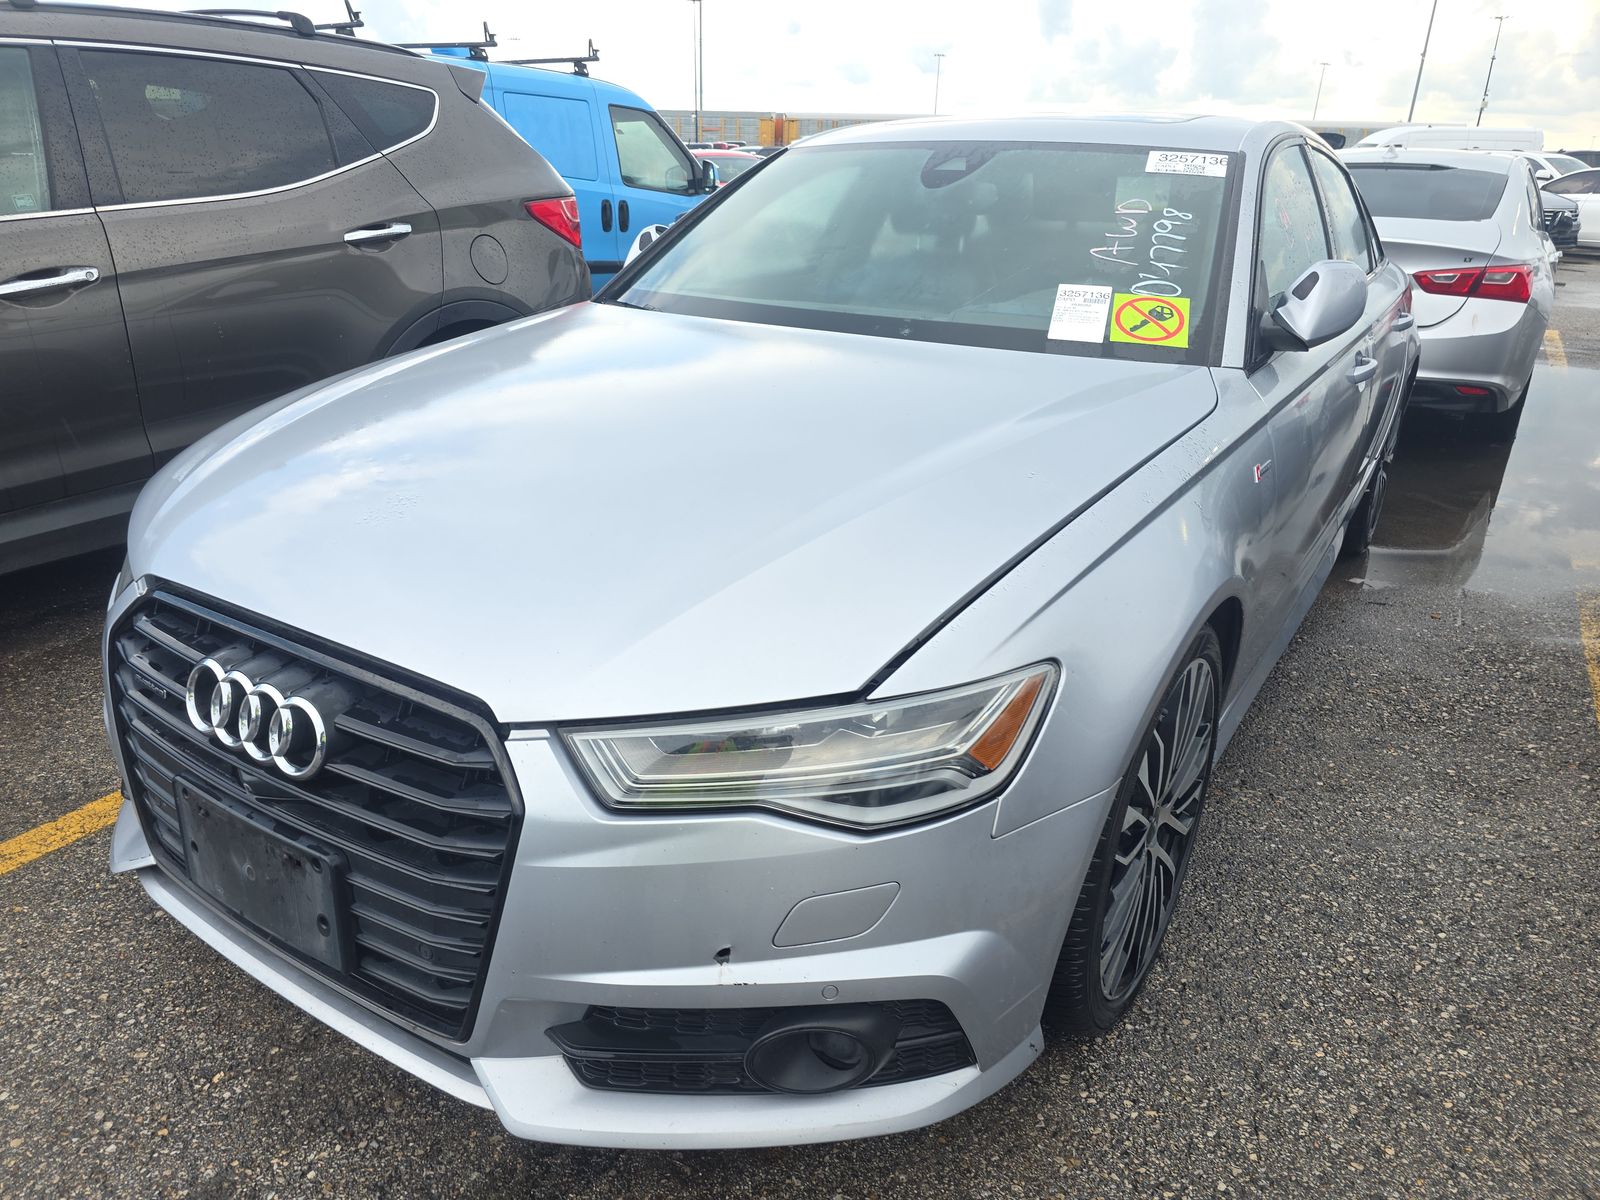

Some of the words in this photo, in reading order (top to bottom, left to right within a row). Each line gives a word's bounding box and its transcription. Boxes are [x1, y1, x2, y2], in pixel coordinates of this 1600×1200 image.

[1158, 153, 1228, 166] 3257136
[1090, 198, 1153, 266] AWD
[1059, 290, 1110, 300] 3257136
